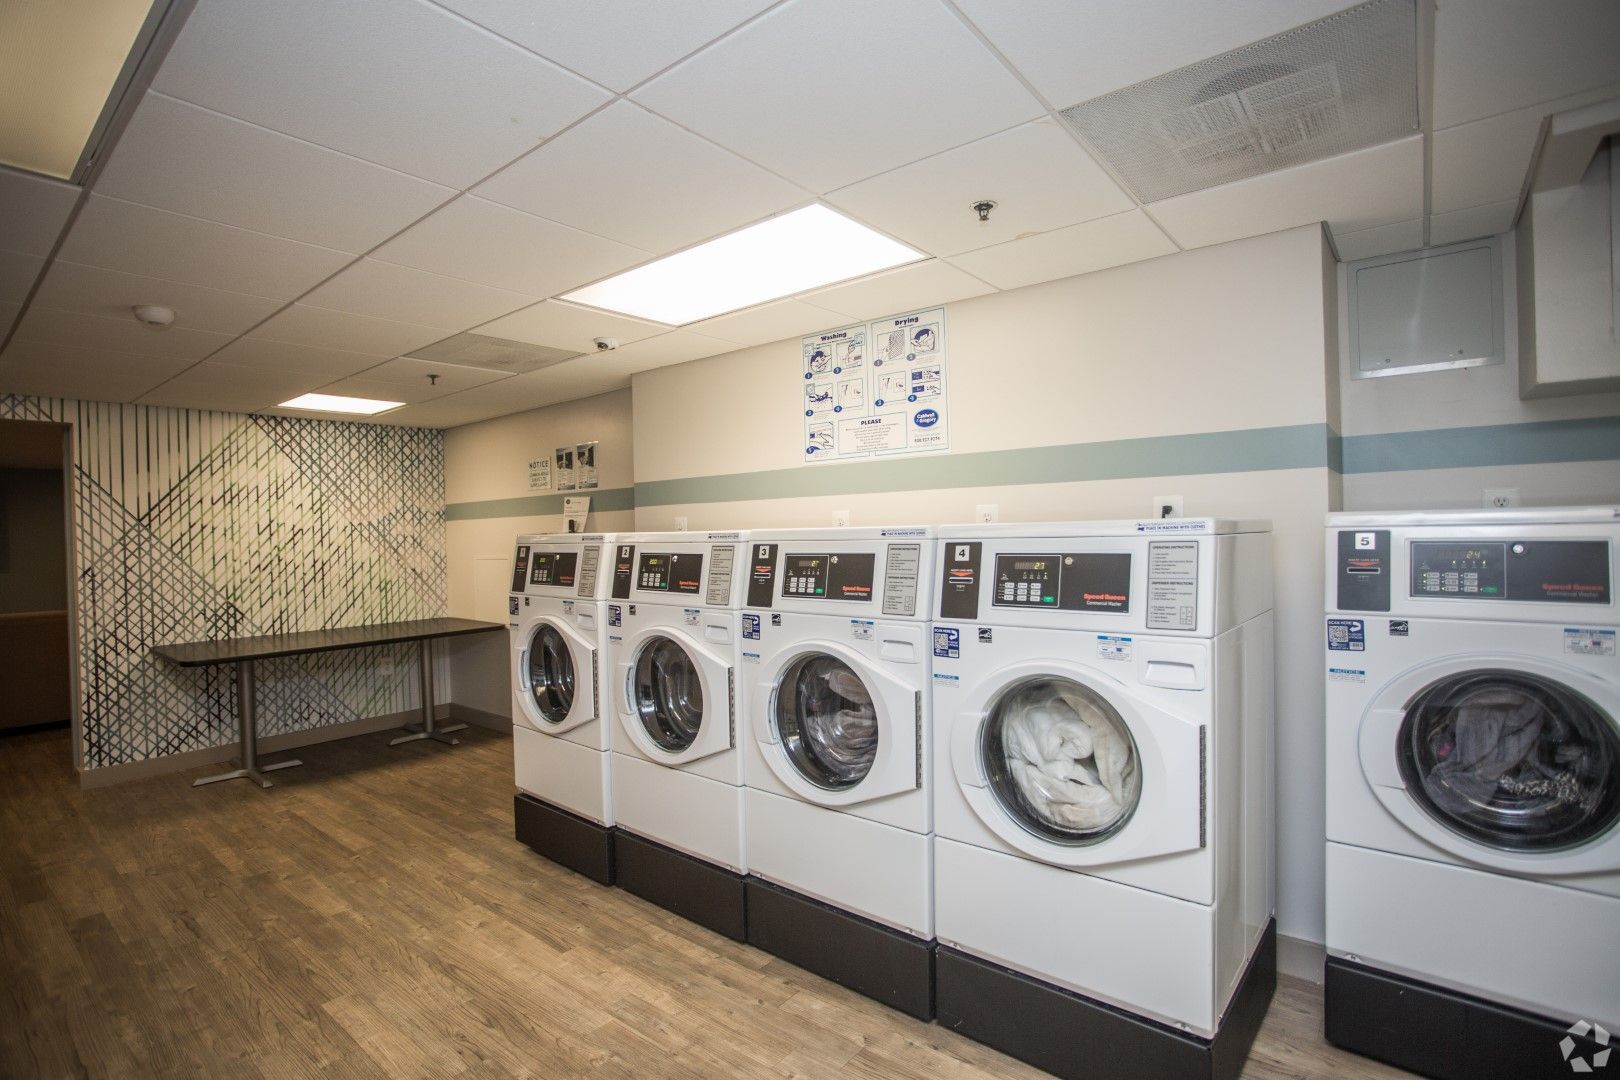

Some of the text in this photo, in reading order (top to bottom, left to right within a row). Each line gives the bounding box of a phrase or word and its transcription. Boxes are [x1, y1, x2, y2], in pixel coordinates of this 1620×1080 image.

[895, 316, 919, 326] Drying
[821, 332, 847, 341] Washing
[529, 460, 548, 469] NOTICE
[1360, 536, 1370, 546] 5
[959, 549, 966, 557] 4
[1466, 550, 1480, 559] 24
